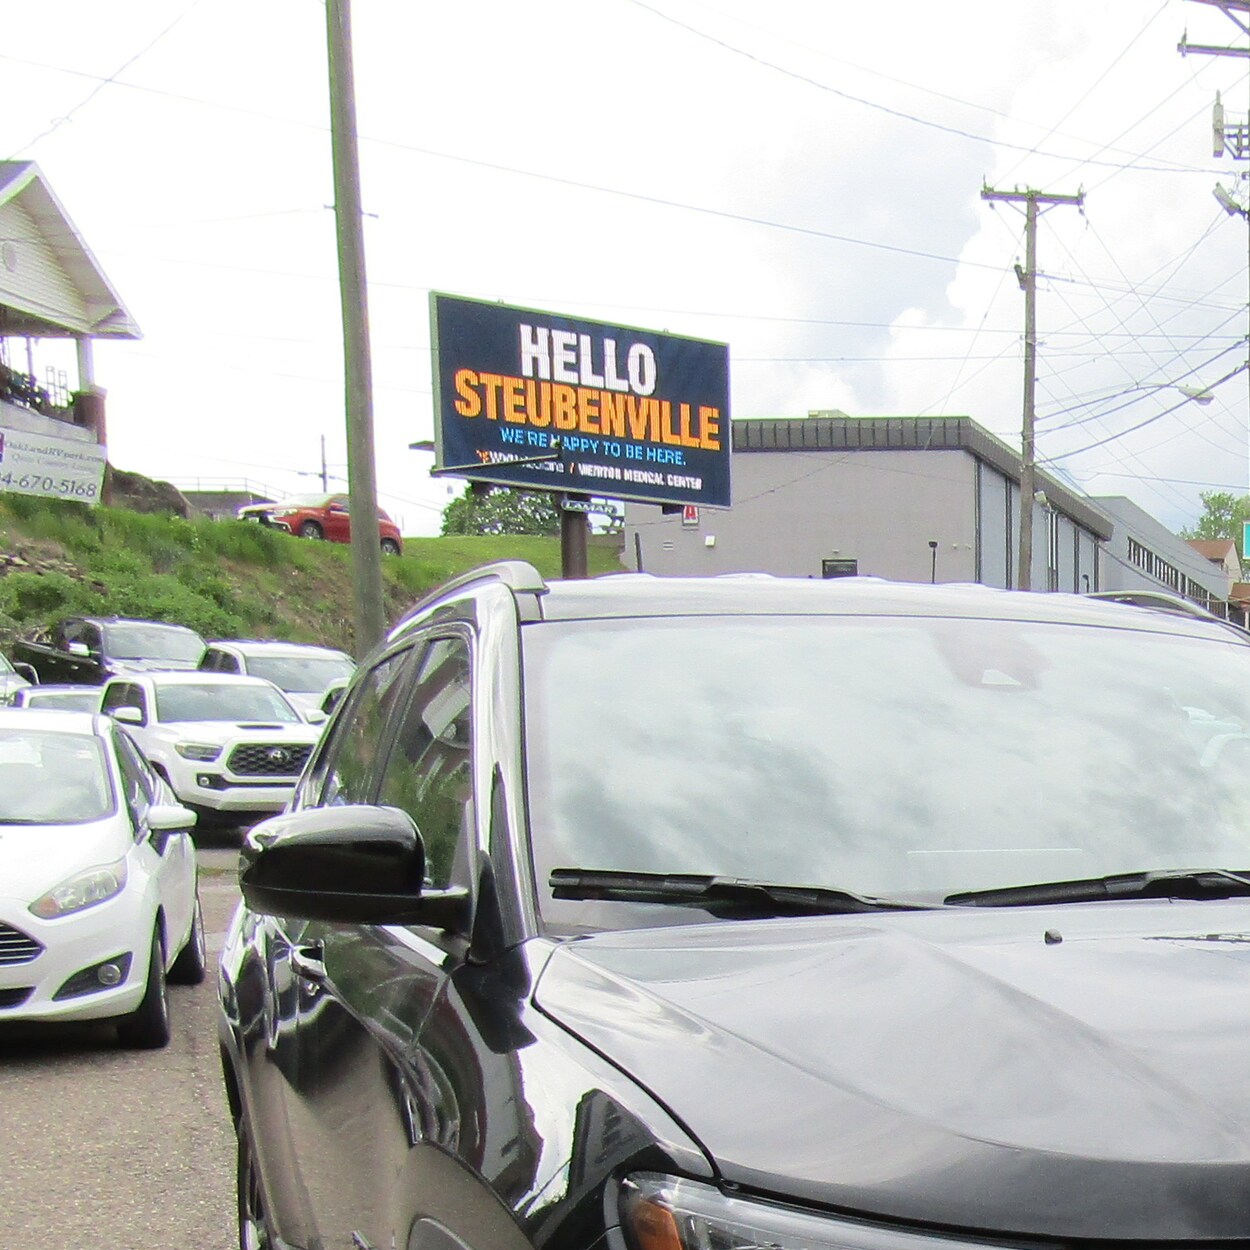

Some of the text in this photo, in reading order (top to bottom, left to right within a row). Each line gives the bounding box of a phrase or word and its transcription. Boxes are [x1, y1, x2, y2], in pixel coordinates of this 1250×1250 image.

[520, 323, 657, 396] HELLO
[454, 368, 720, 451] STEUBENVILLE
[550, 433, 600, 454] HAPPY
[603, 441, 621, 458] TO
[626, 443, 643, 460] BE
[646, 447, 687, 466] HERE.
[623, 468, 665, 486] MEDICAL
[667, 473, 702, 490] CENTER
